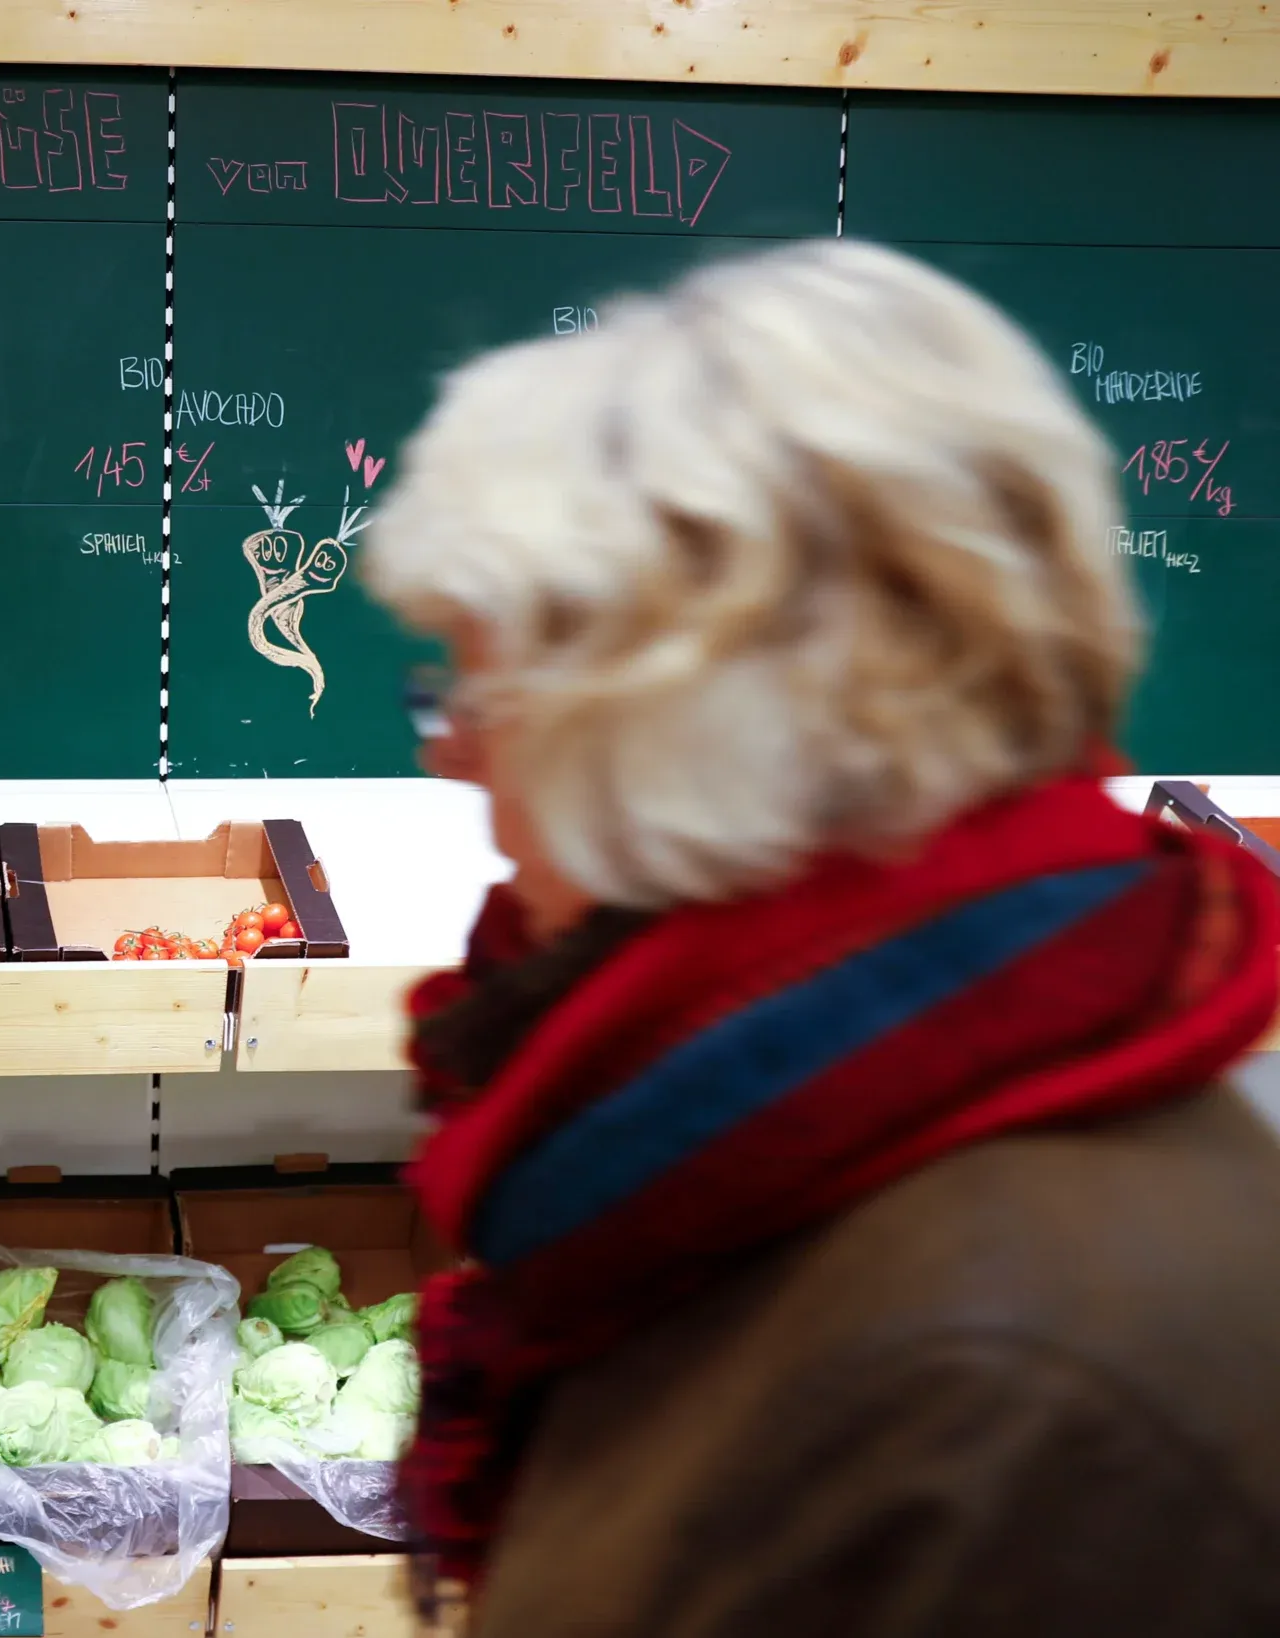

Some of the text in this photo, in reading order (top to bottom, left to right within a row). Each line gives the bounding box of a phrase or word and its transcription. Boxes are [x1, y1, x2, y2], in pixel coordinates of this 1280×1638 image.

[331, 102, 732, 226] QUERFELD
[553, 305, 599, 336] BIO
[119, 356, 164, 391] BIO
[1069, 341, 1105, 377] BIO
[175, 389, 285, 430] AVOCADO
[79, 532, 146, 556] SPANIEN
[1105, 525, 1167, 558] ITALIEN
